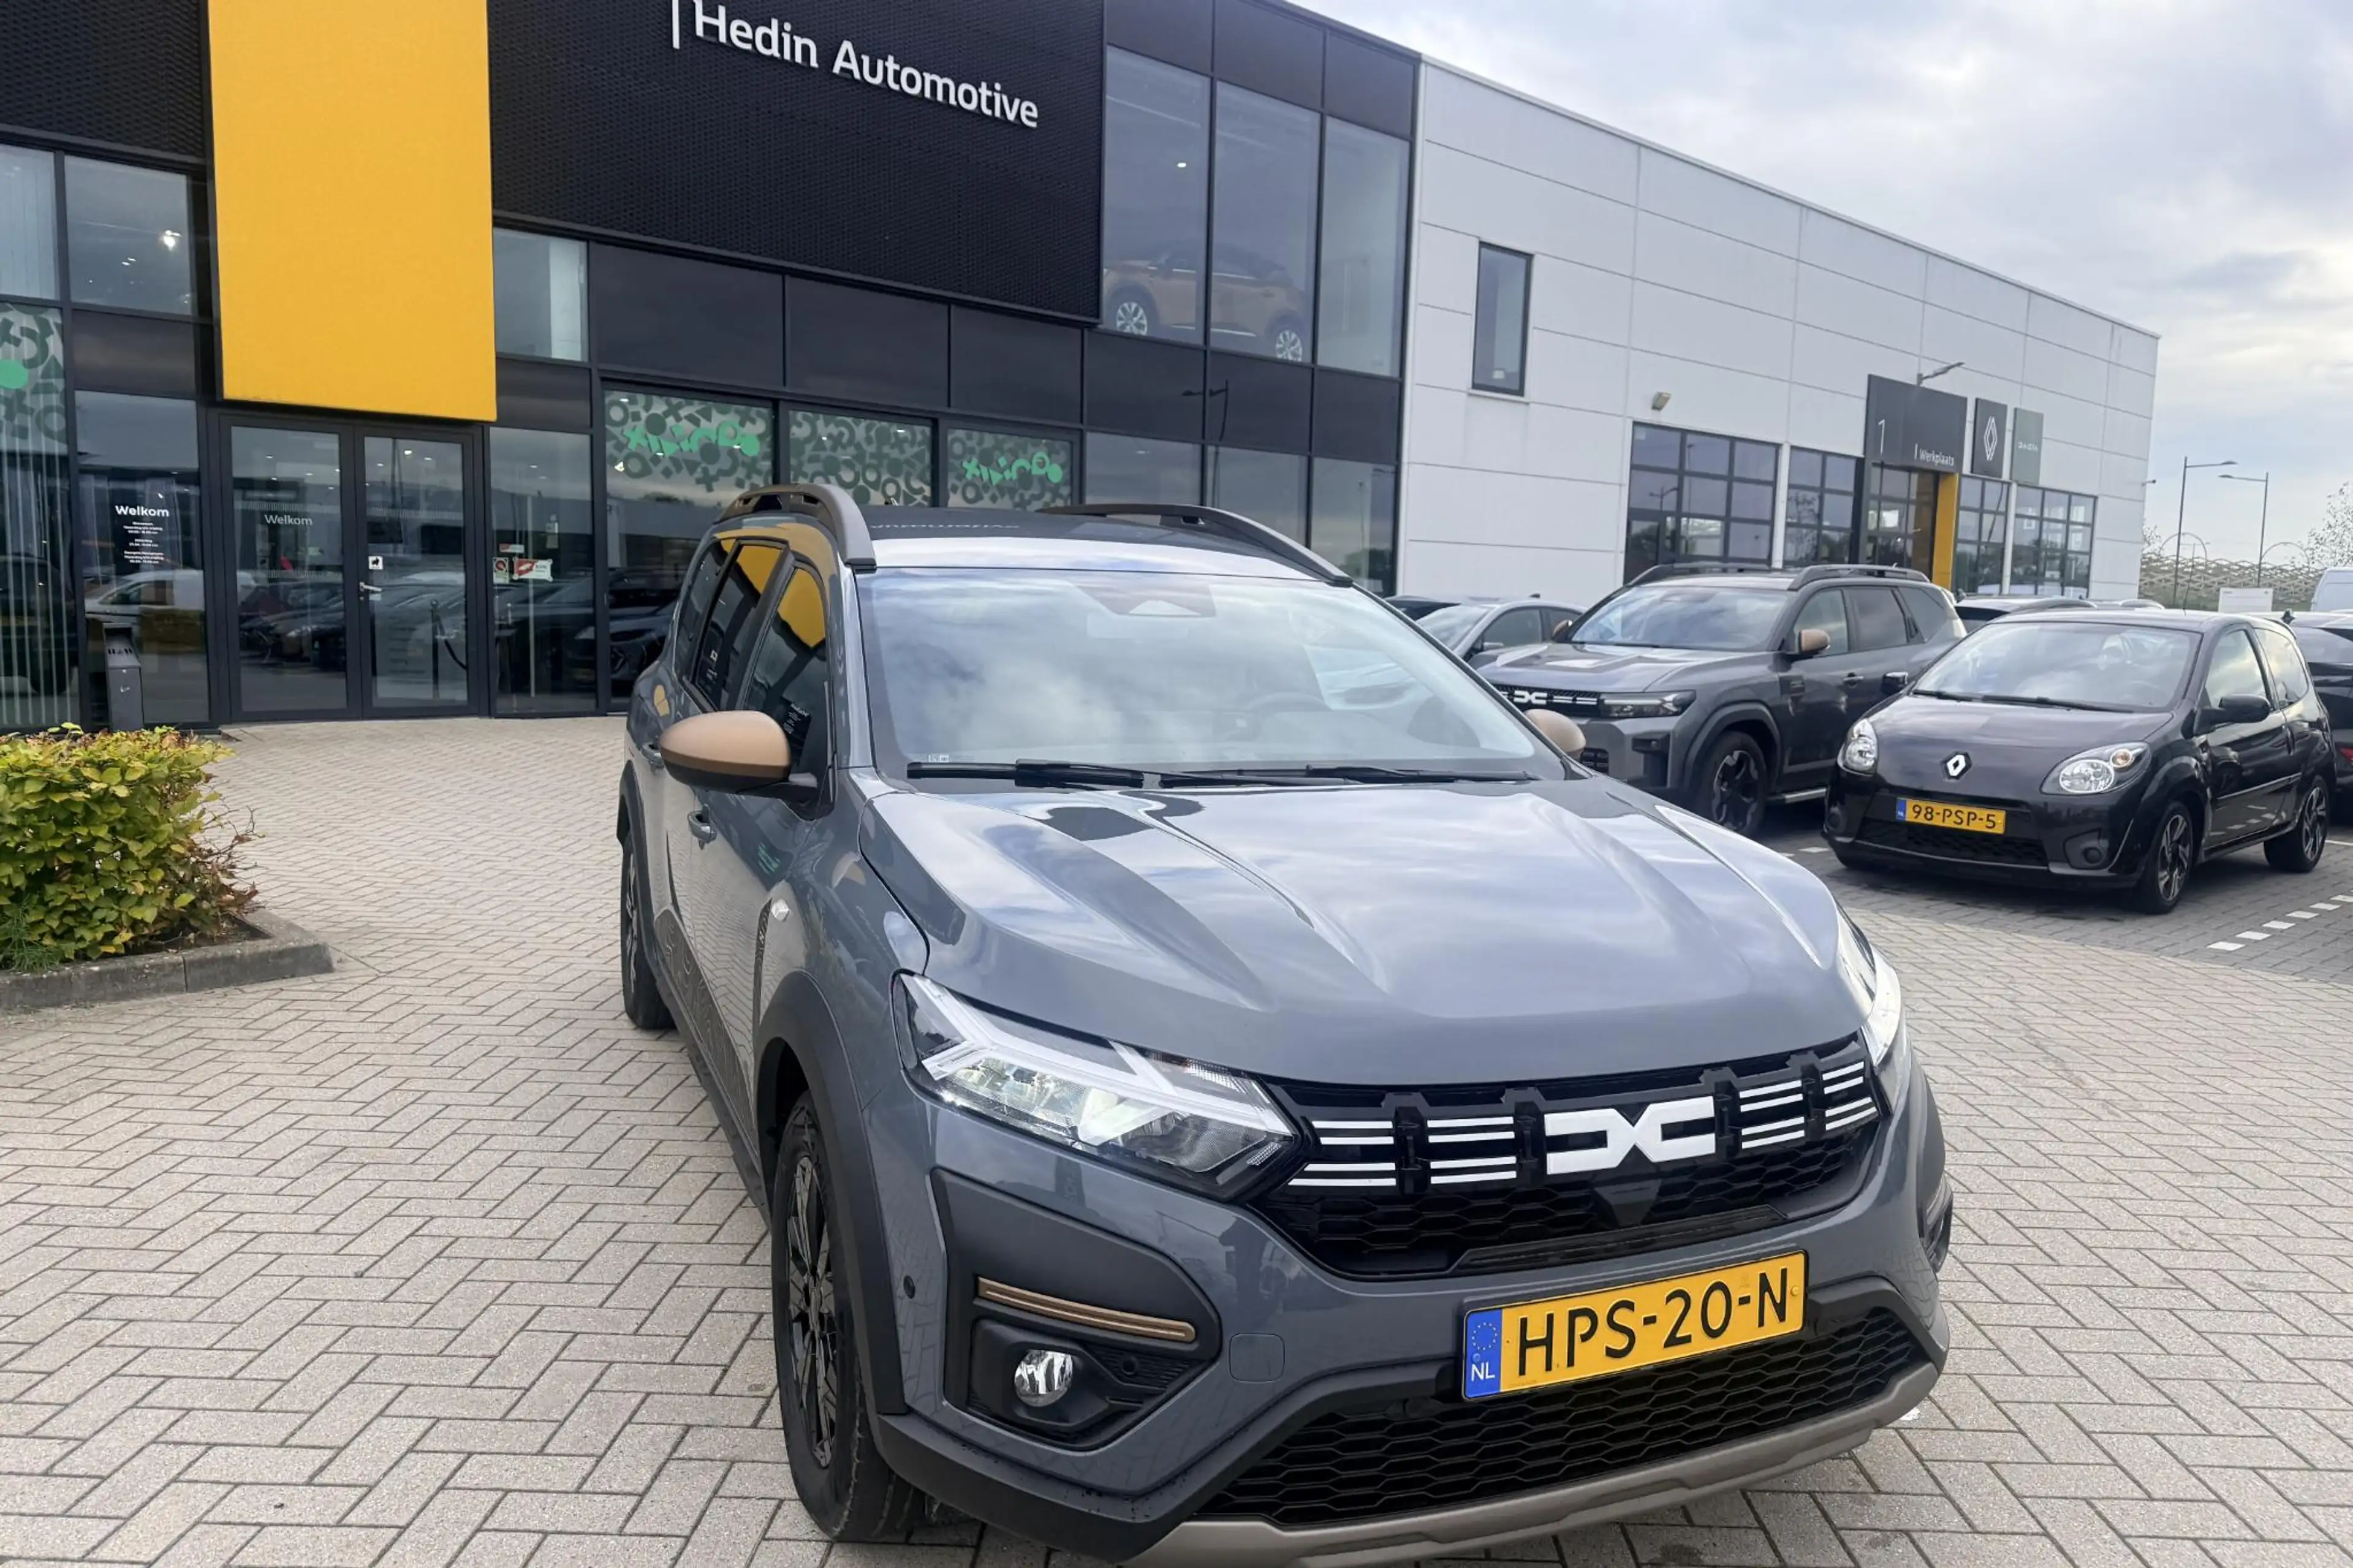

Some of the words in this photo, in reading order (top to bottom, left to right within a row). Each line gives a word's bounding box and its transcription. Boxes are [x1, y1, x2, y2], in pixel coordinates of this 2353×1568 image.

[693, 0, 818, 68] Hedin
[832, 40, 1039, 128] Automotive
[115, 505, 169, 517] Welkom
[264, 514, 313, 526] Welkom
[1912, 804, 1996, 829] 98-PSP-5
[1471, 1362, 1495, 1381] NL
[1518, 1268, 1789, 1377] HPS-20-N
